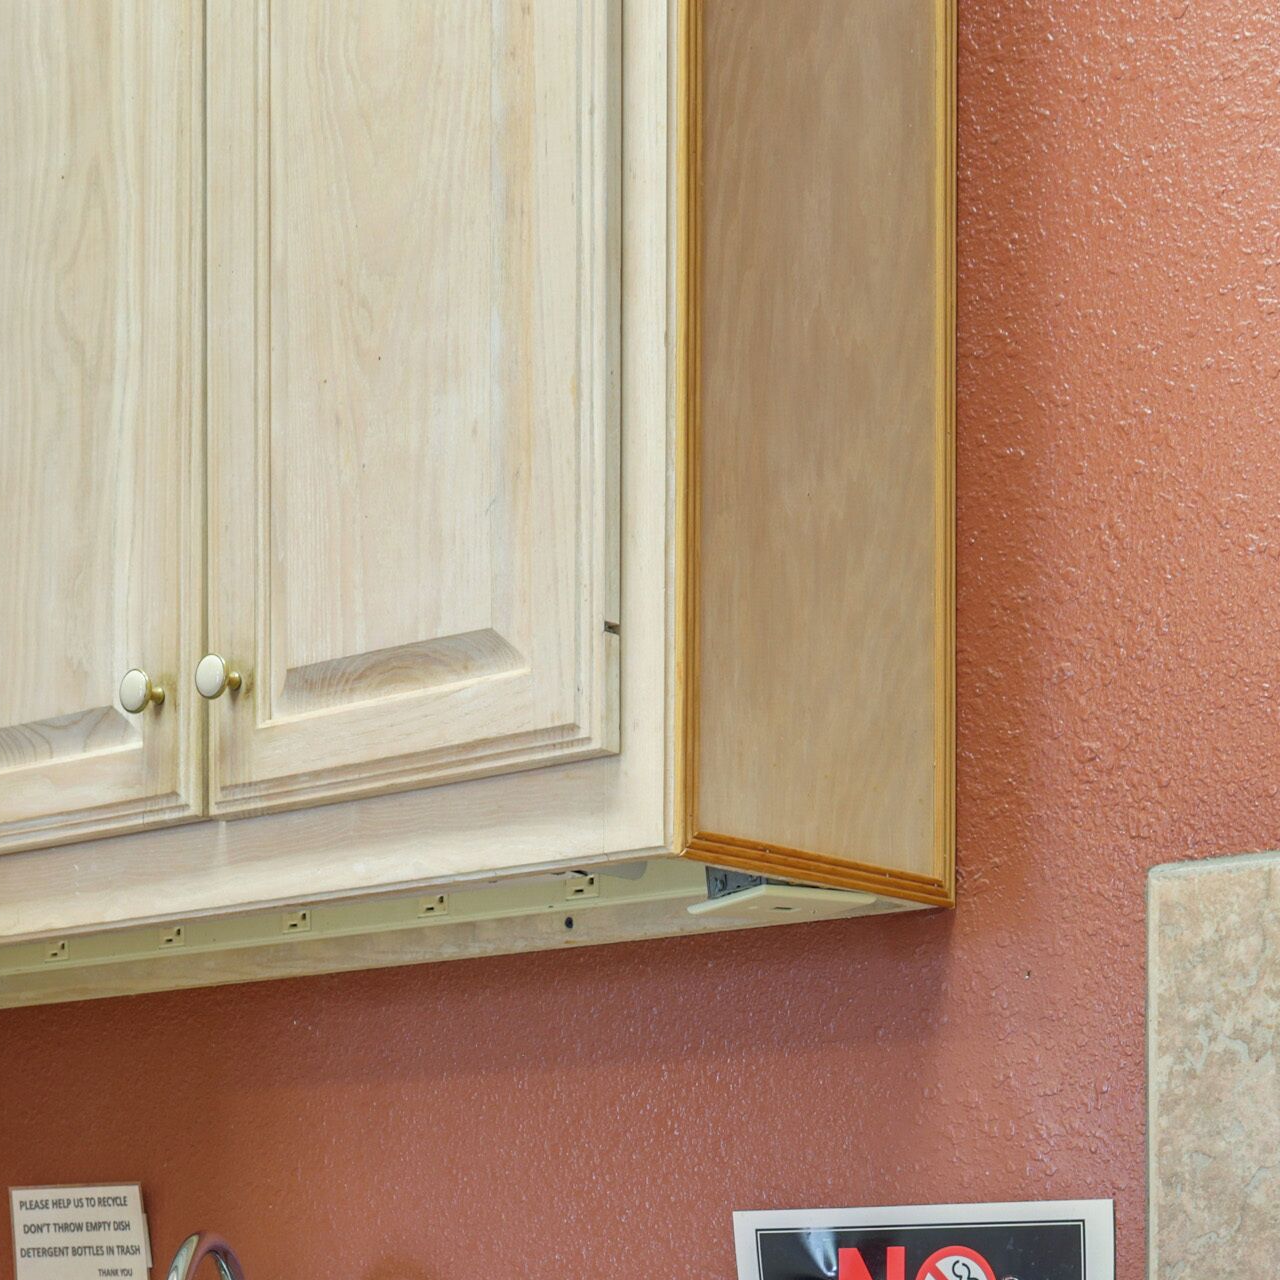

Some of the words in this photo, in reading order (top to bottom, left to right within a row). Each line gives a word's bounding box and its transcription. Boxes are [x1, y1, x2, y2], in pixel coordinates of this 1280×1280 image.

[19, 1199, 50, 1211] PLEASE
[51, 1198, 72, 1209] HELP
[73, 1198, 84, 1208] US
[85, 1197, 96, 1208] TO
[97, 1196, 128, 1208] RECYCLE
[23, 1223, 51, 1234] DON'T
[53, 1222, 84, 1233] THROW
[85, 1221, 112, 1232] EMPTY
[113, 1220, 131, 1231] DISH
[20, 1246, 70, 1258] DETERGENT
[71, 1245, 105, 1256] BOTTLES
[106, 1245, 115, 1256] IN
[116, 1244, 141, 1256] TRASH
[98, 1268, 119, 1277] THANK
[120, 1268, 133, 1277] YOU
